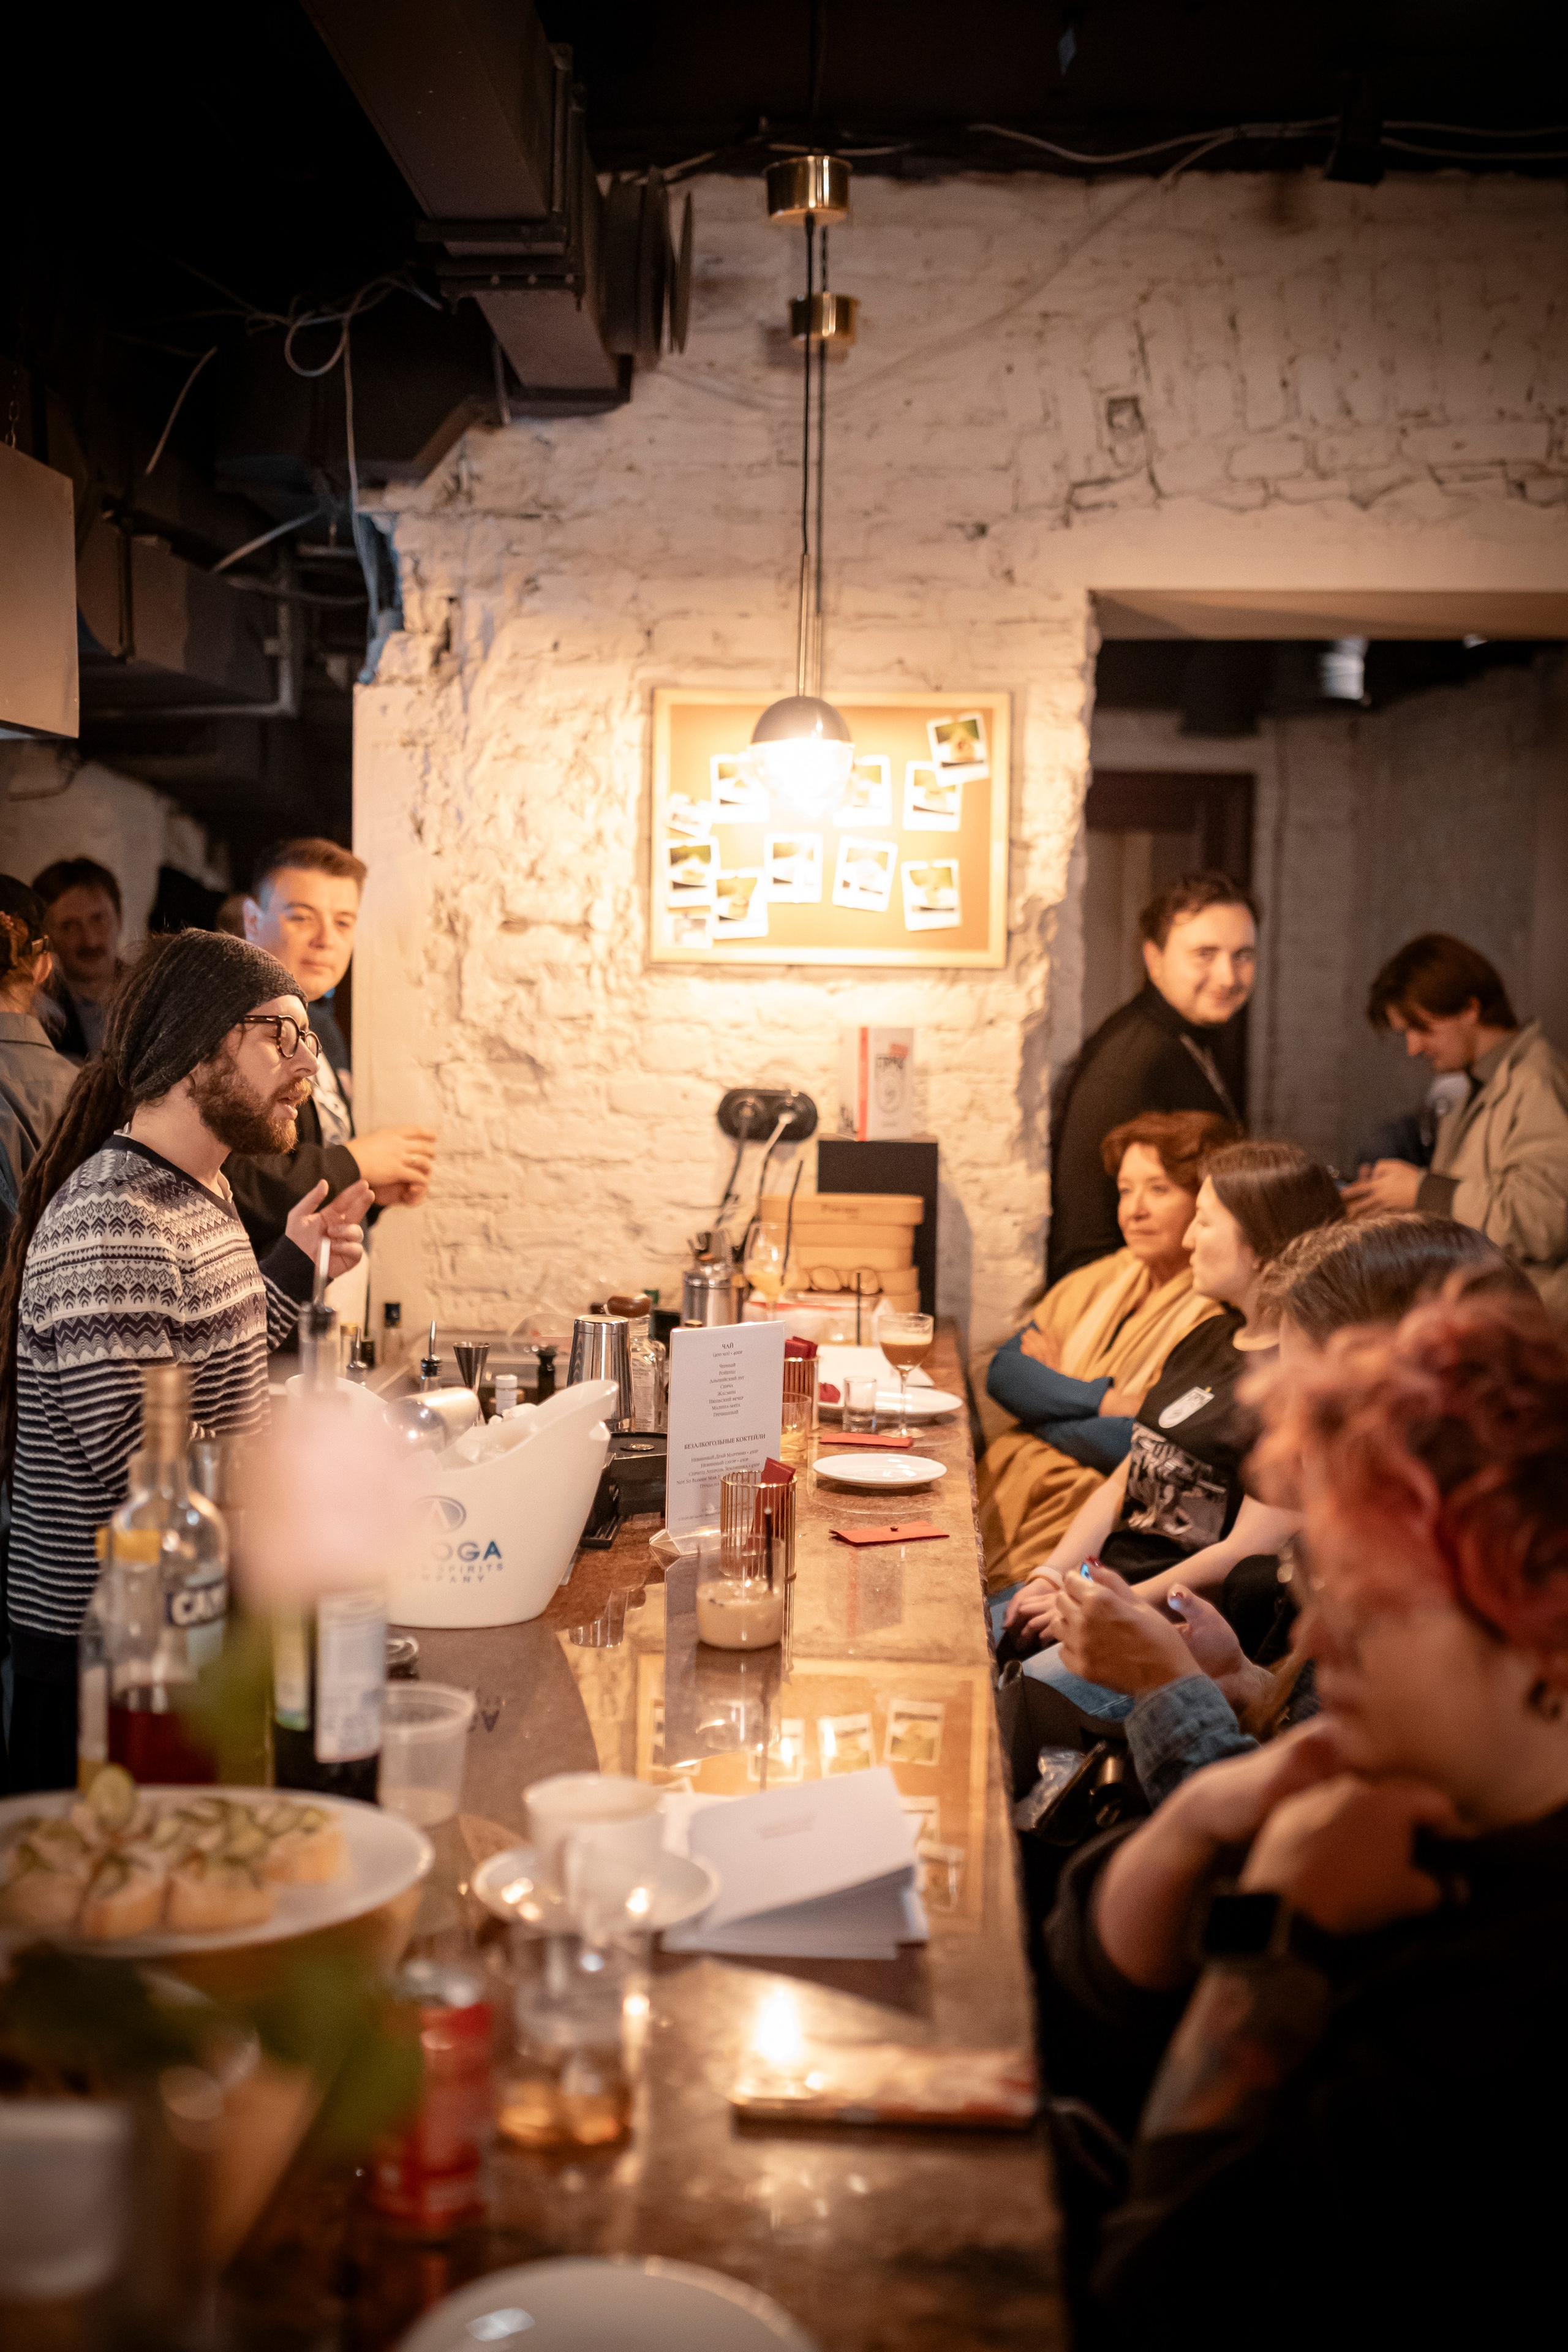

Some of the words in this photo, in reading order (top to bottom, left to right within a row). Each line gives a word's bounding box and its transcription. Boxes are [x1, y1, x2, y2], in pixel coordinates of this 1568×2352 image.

[684, 1438, 735, 1450] БЕЗАЛКОГОЛЬНЫЕ
[736, 1434, 766, 1443] КОКТЕЙЛИ
[431, 1540, 502, 1562] OGA
